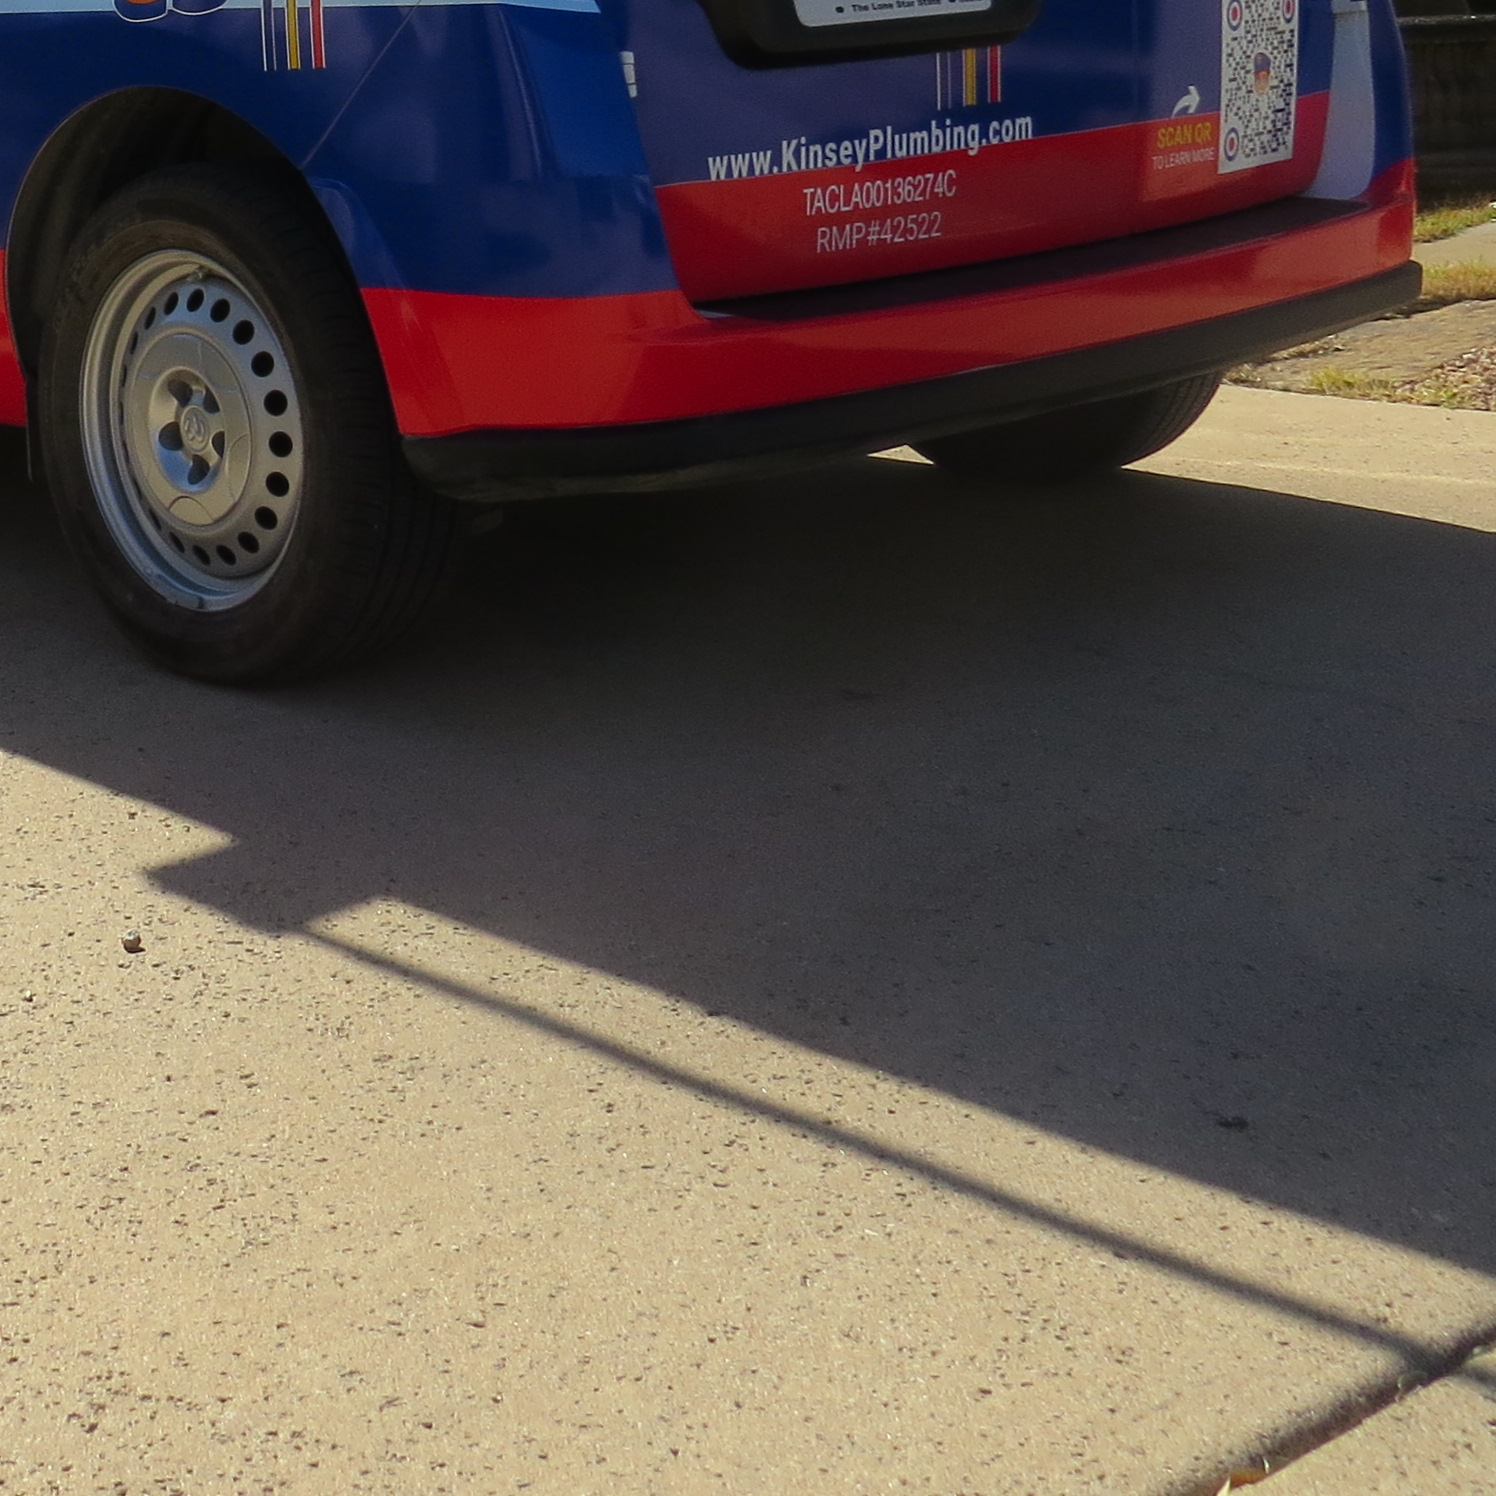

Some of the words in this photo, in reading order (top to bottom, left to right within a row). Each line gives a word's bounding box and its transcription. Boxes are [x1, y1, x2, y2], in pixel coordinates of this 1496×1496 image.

[707, 115, 1033, 182] www.KinseyPlumbing.com
[1157, 125, 1193, 149] SCAN
[1194, 121, 1212, 144] QR
[802, 169, 958, 217] TACLA00136274C
[816, 211, 943, 254] RMP#42522
